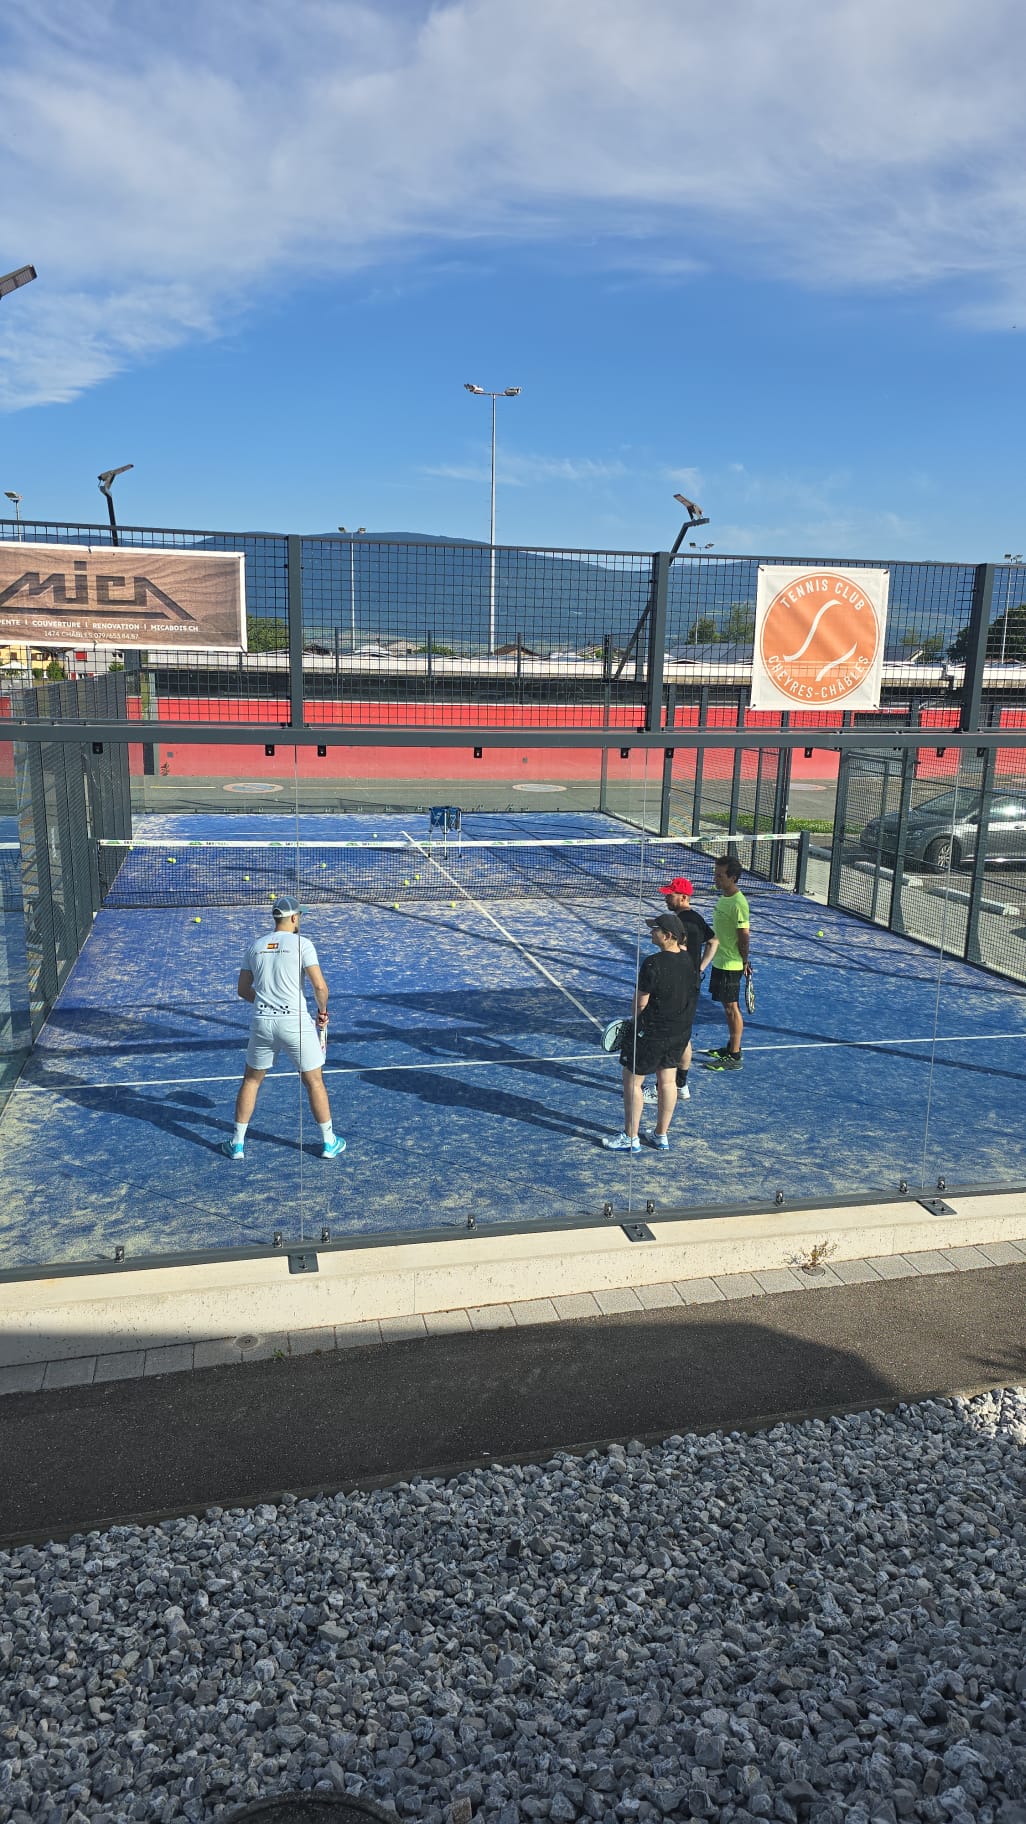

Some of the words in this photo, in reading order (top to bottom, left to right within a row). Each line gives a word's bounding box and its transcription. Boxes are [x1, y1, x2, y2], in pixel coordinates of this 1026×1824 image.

[780, 579, 829, 609] TENNIS
[835, 582, 865, 610] CLUB
[32, 619, 81, 628] COUVERTURE
[768, 655, 869, 699] CHEYRES-CHÂBLES
